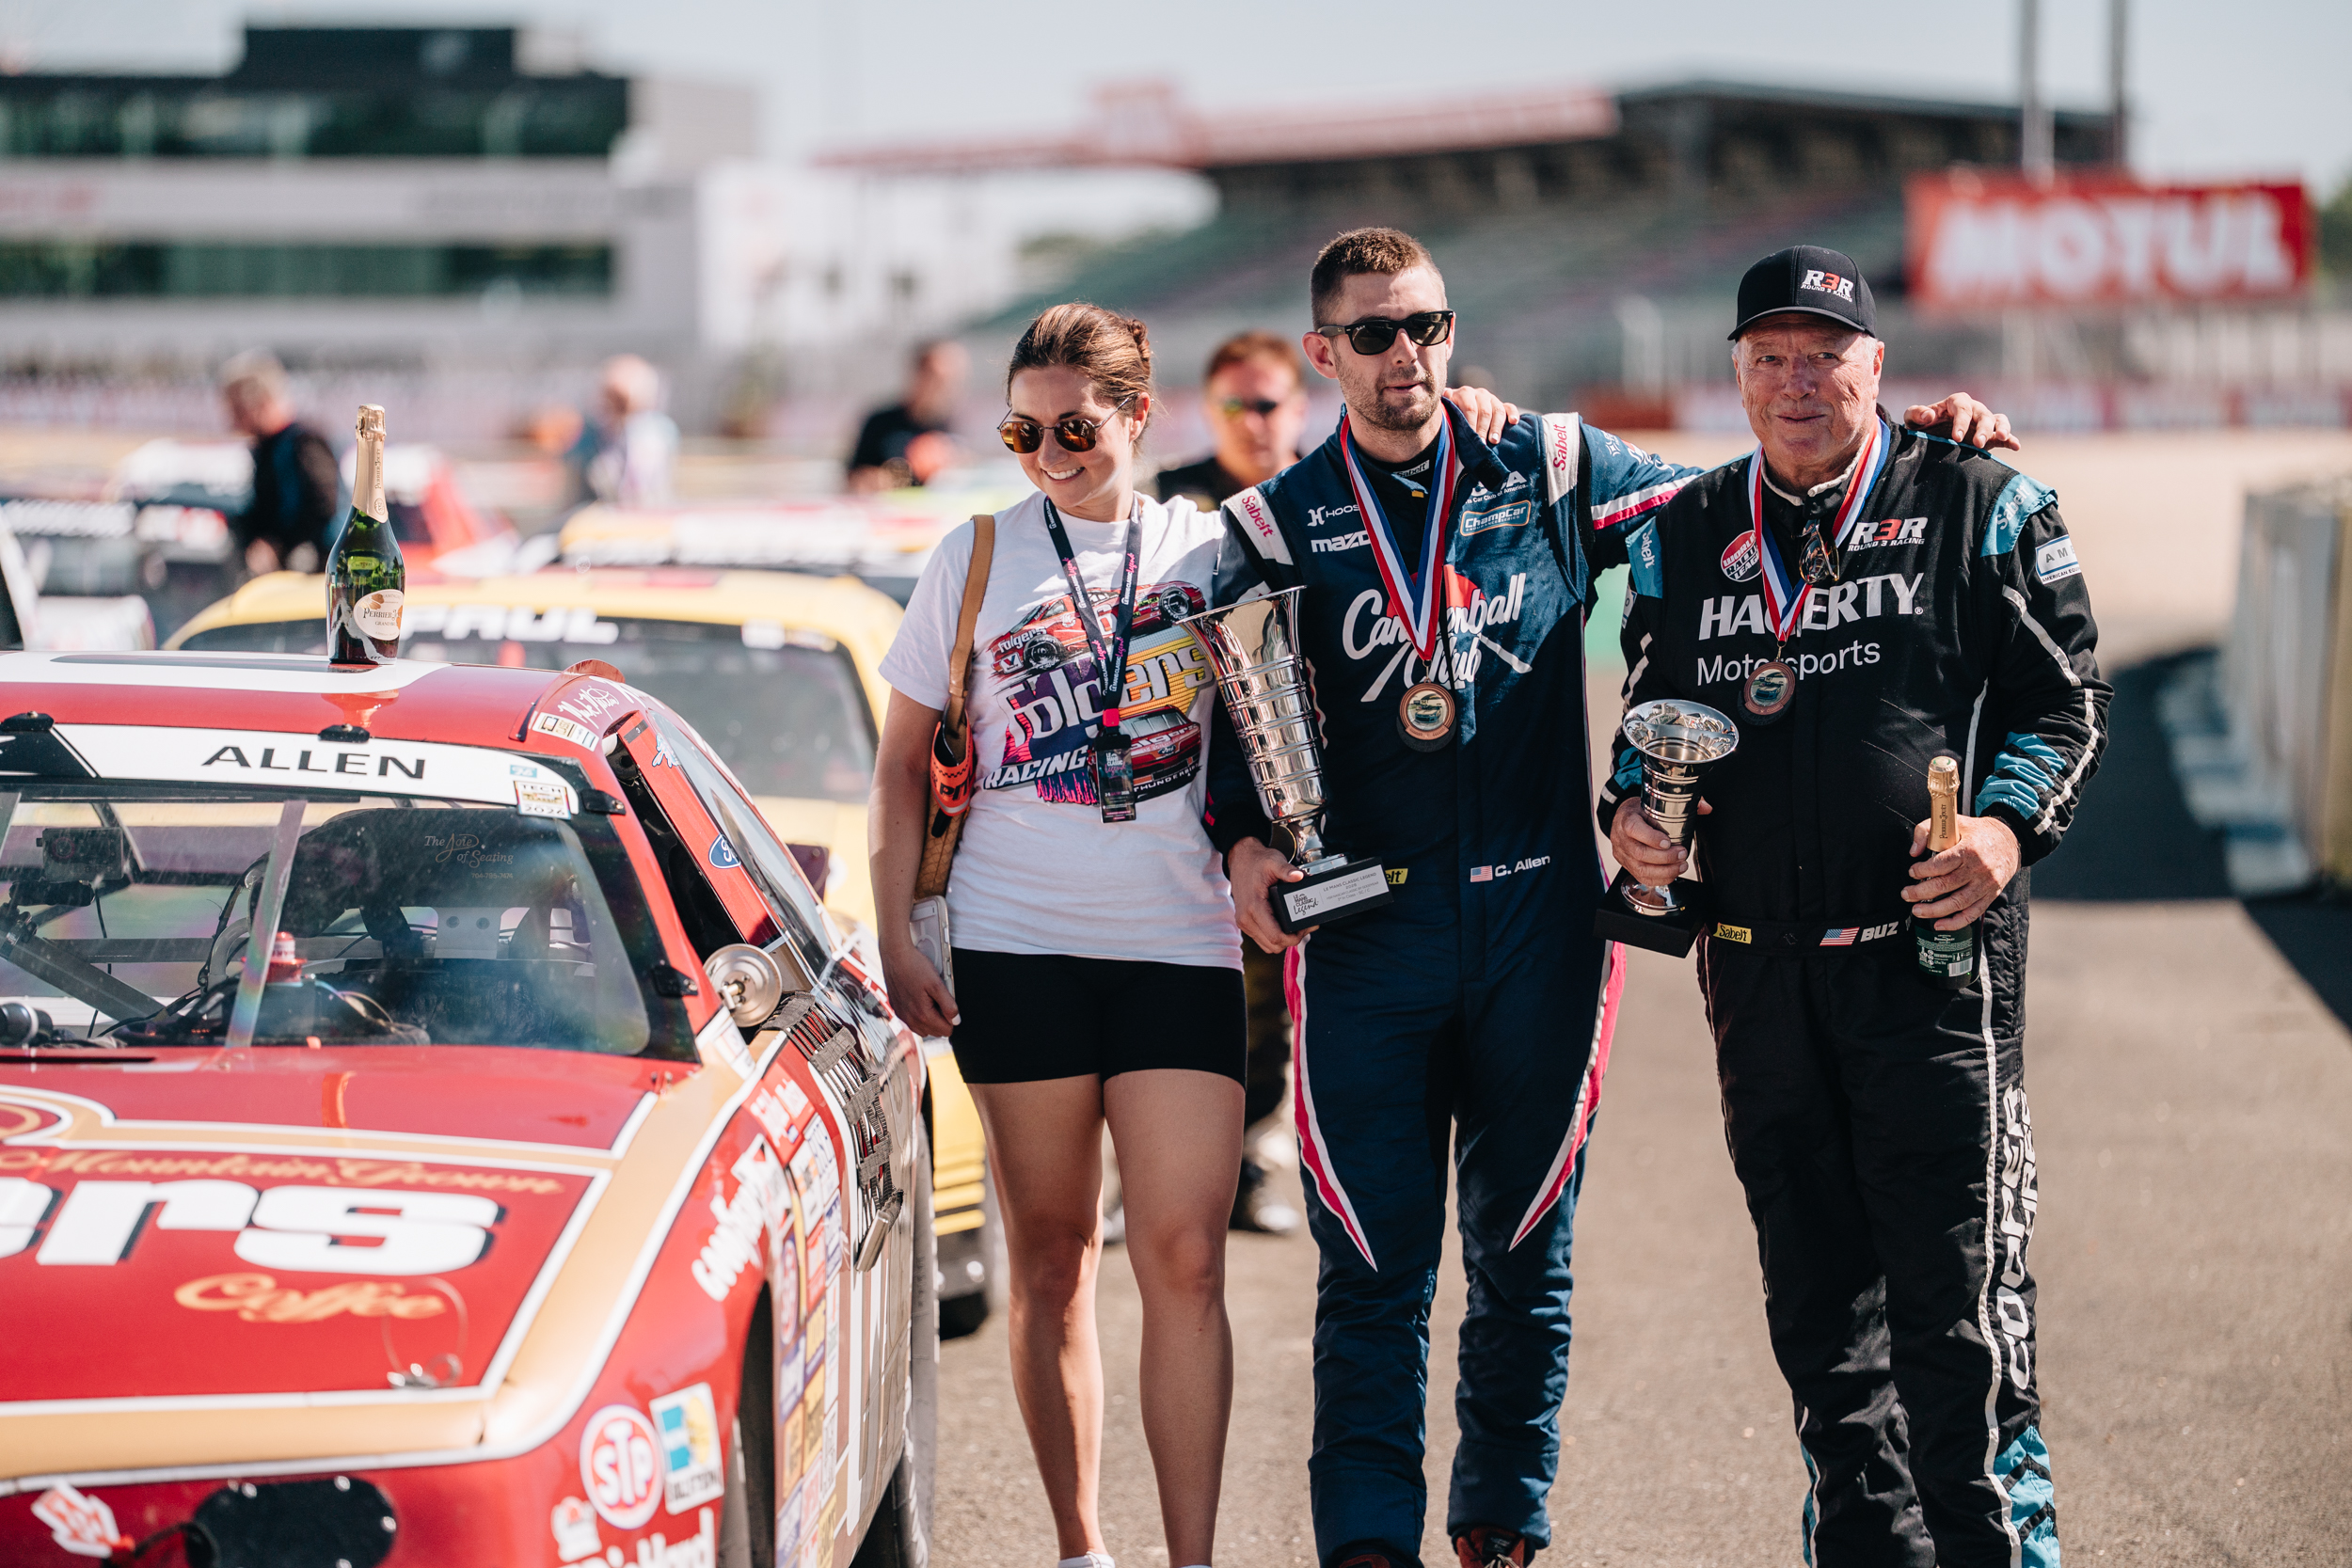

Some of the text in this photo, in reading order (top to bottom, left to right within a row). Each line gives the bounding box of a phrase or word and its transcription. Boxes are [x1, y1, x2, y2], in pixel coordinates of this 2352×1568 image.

[1932, 193, 2296, 294] MOTUL
[1800, 283, 1825, 292] ROUND
[1803, 269, 1854, 297] R3R
[1552, 423, 1568, 471] Sabelt
[1241, 495, 1275, 538] Sabelt
[1464, 506, 1527, 529] ChampCar
[1994, 484, 2031, 531] Sabelt
[1846, 541, 1879, 552] ROUND
[1889, 537, 1925, 546] RACING
[1849, 516, 1929, 546] R3R
[1698, 573, 1925, 641] HAERTY
[399, 603, 620, 645] PAUL
[1697, 640, 1881, 687] Motsports
[200, 746, 425, 780] ALLEN
[984, 744, 1089, 790] RACING
[521, 784, 562, 794] TECH
[423, 835, 445, 847] The
[456, 849, 514, 869] of Seating
[1494, 855, 1551, 878] C. Allen
[1385, 869, 1402, 884] elt
[1293, 898, 1318, 916] Legend
[1719, 926, 1748, 942] Sabelt
[1860, 921, 1899, 942] BUZ
[1996, 1083, 2030, 1390] COOPER
[174, 1273, 447, 1323] Coffee
[592, 1419, 655, 1507] STP
